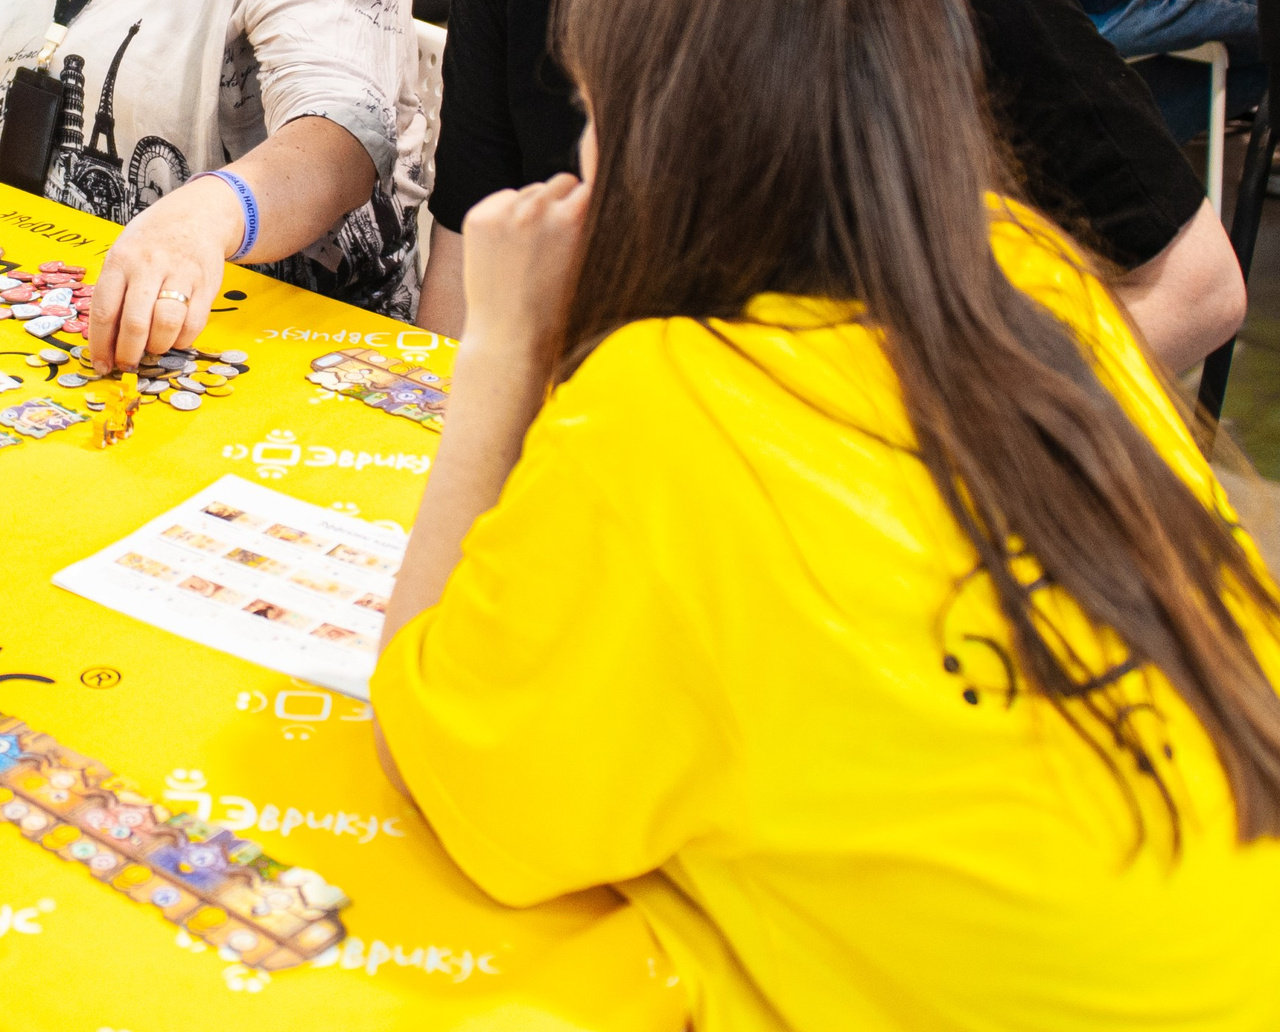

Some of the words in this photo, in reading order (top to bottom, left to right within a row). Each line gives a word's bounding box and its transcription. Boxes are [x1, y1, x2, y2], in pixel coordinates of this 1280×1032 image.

[263, 326, 393, 348] Эврикус
[304, 446, 431, 475] Эврику
[218, 795, 406, 844] Эврикус
